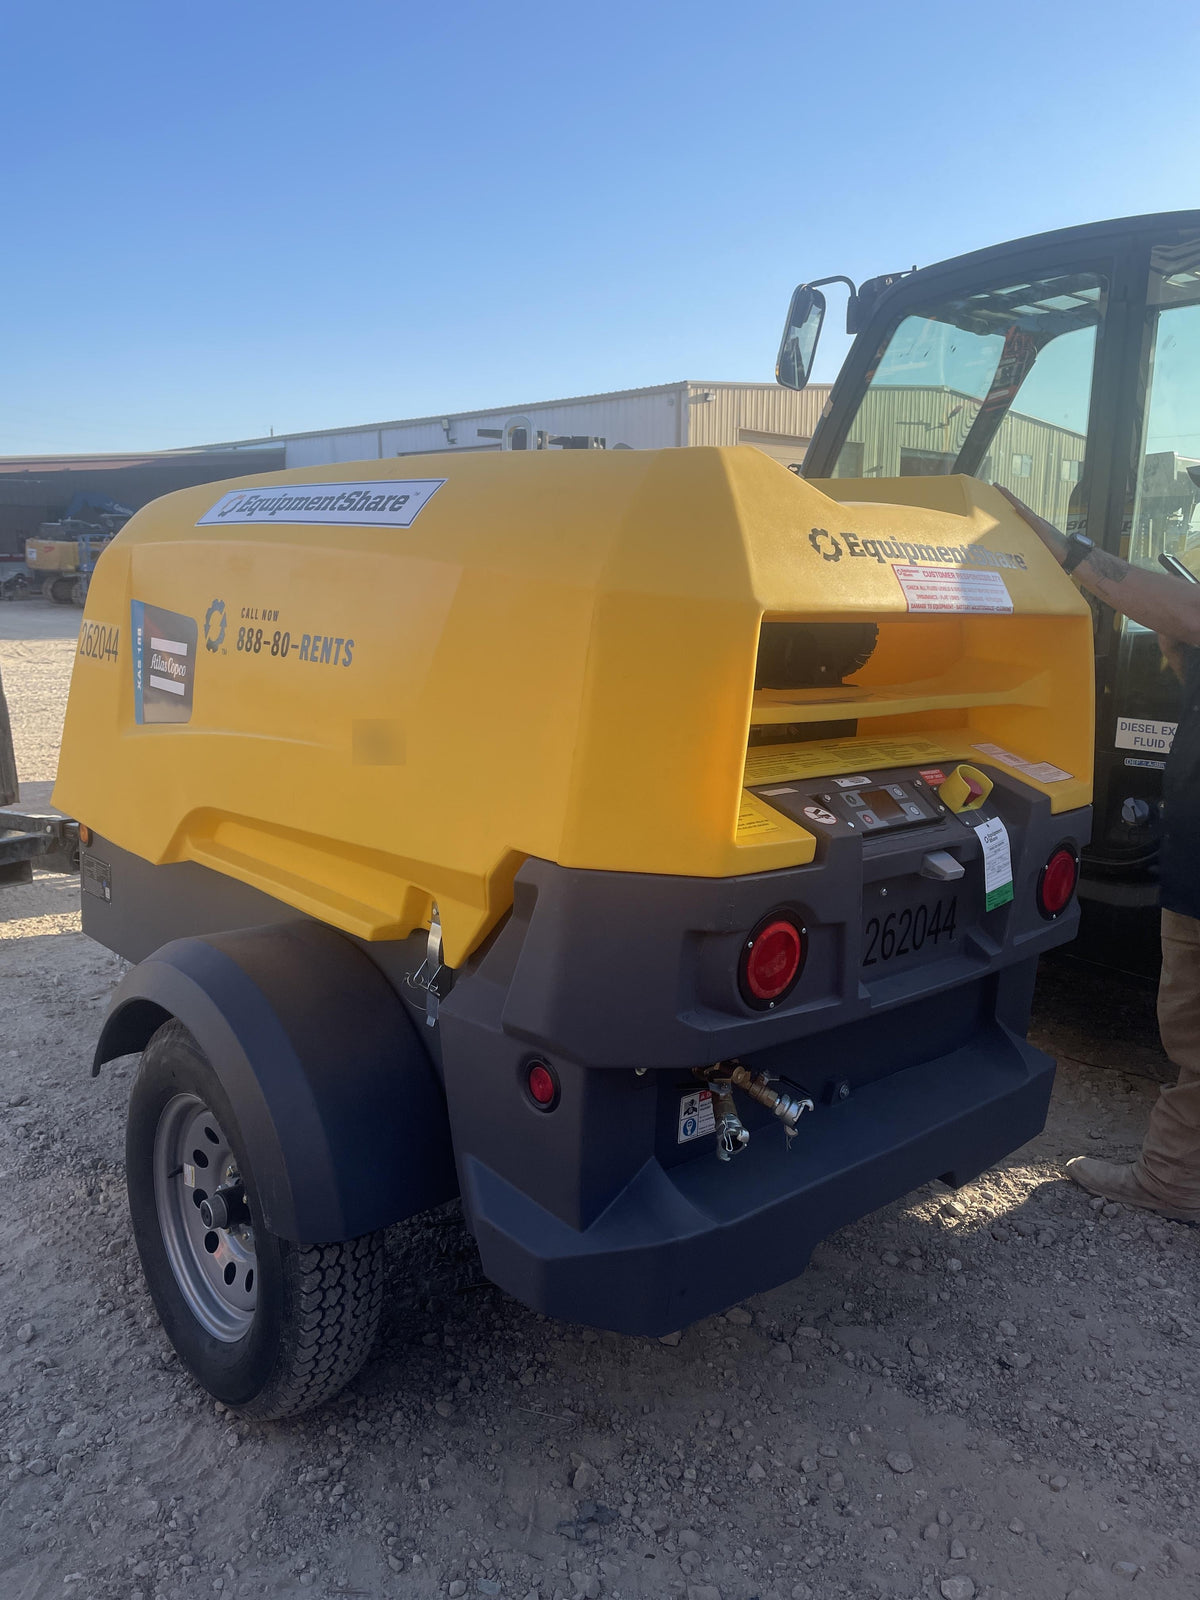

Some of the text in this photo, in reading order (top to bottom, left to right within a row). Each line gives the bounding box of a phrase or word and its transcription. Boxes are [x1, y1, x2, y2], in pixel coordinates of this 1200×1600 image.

[236, 490, 410, 516] EquipmentShare
[840, 532, 1028, 570] EquipmentShare
[922, 570, 956, 579] CUSTOMER
[241, 608, 279, 622] CALL NOW
[79, 622, 120, 663] 262044
[237, 626, 354, 667] 888-80-RENTS
[150, 653, 187, 678] Atlas Copco
[1120, 721, 1158, 735] DIESEL
[1134, 736, 1166, 749] FLUID
[862, 895, 958, 967] 262044
